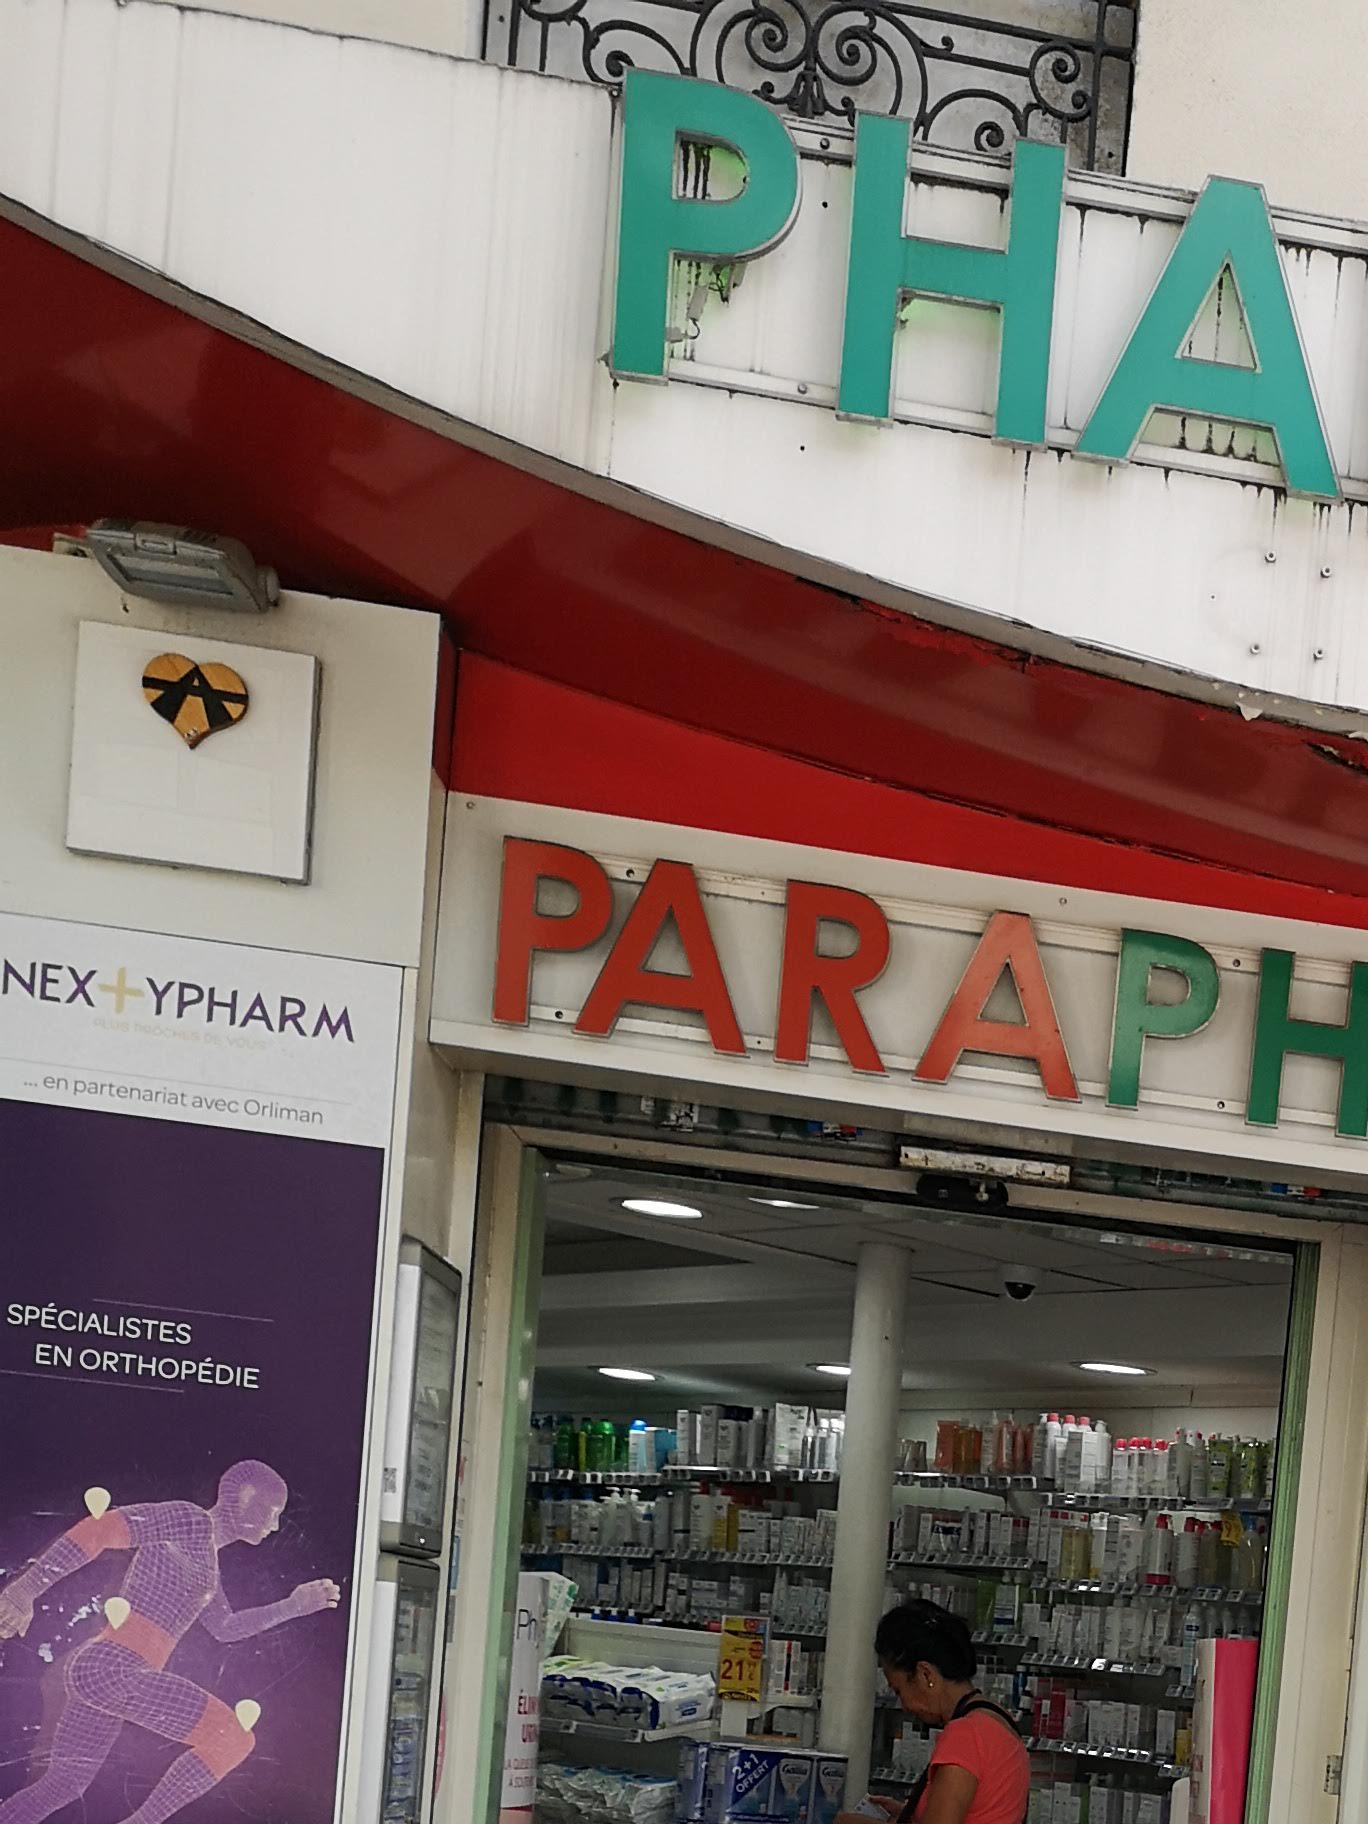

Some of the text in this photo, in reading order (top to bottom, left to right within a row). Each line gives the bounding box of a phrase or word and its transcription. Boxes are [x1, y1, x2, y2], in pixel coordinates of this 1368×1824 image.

[43, 1076, 69, 1091] en
[73, 1078, 187, 1106] partenariat
[192, 1098, 239, 1113] avec
[244, 1099, 324, 1125] Orliman
[7, 1302, 192, 1345] SPÉCIALISTES
[35, 1343, 260, 1389] EN ORTHOPÉDIE
[732, 1753, 760, 1781] 2+1
[735, 1760, 770, 1795] OFFERT
